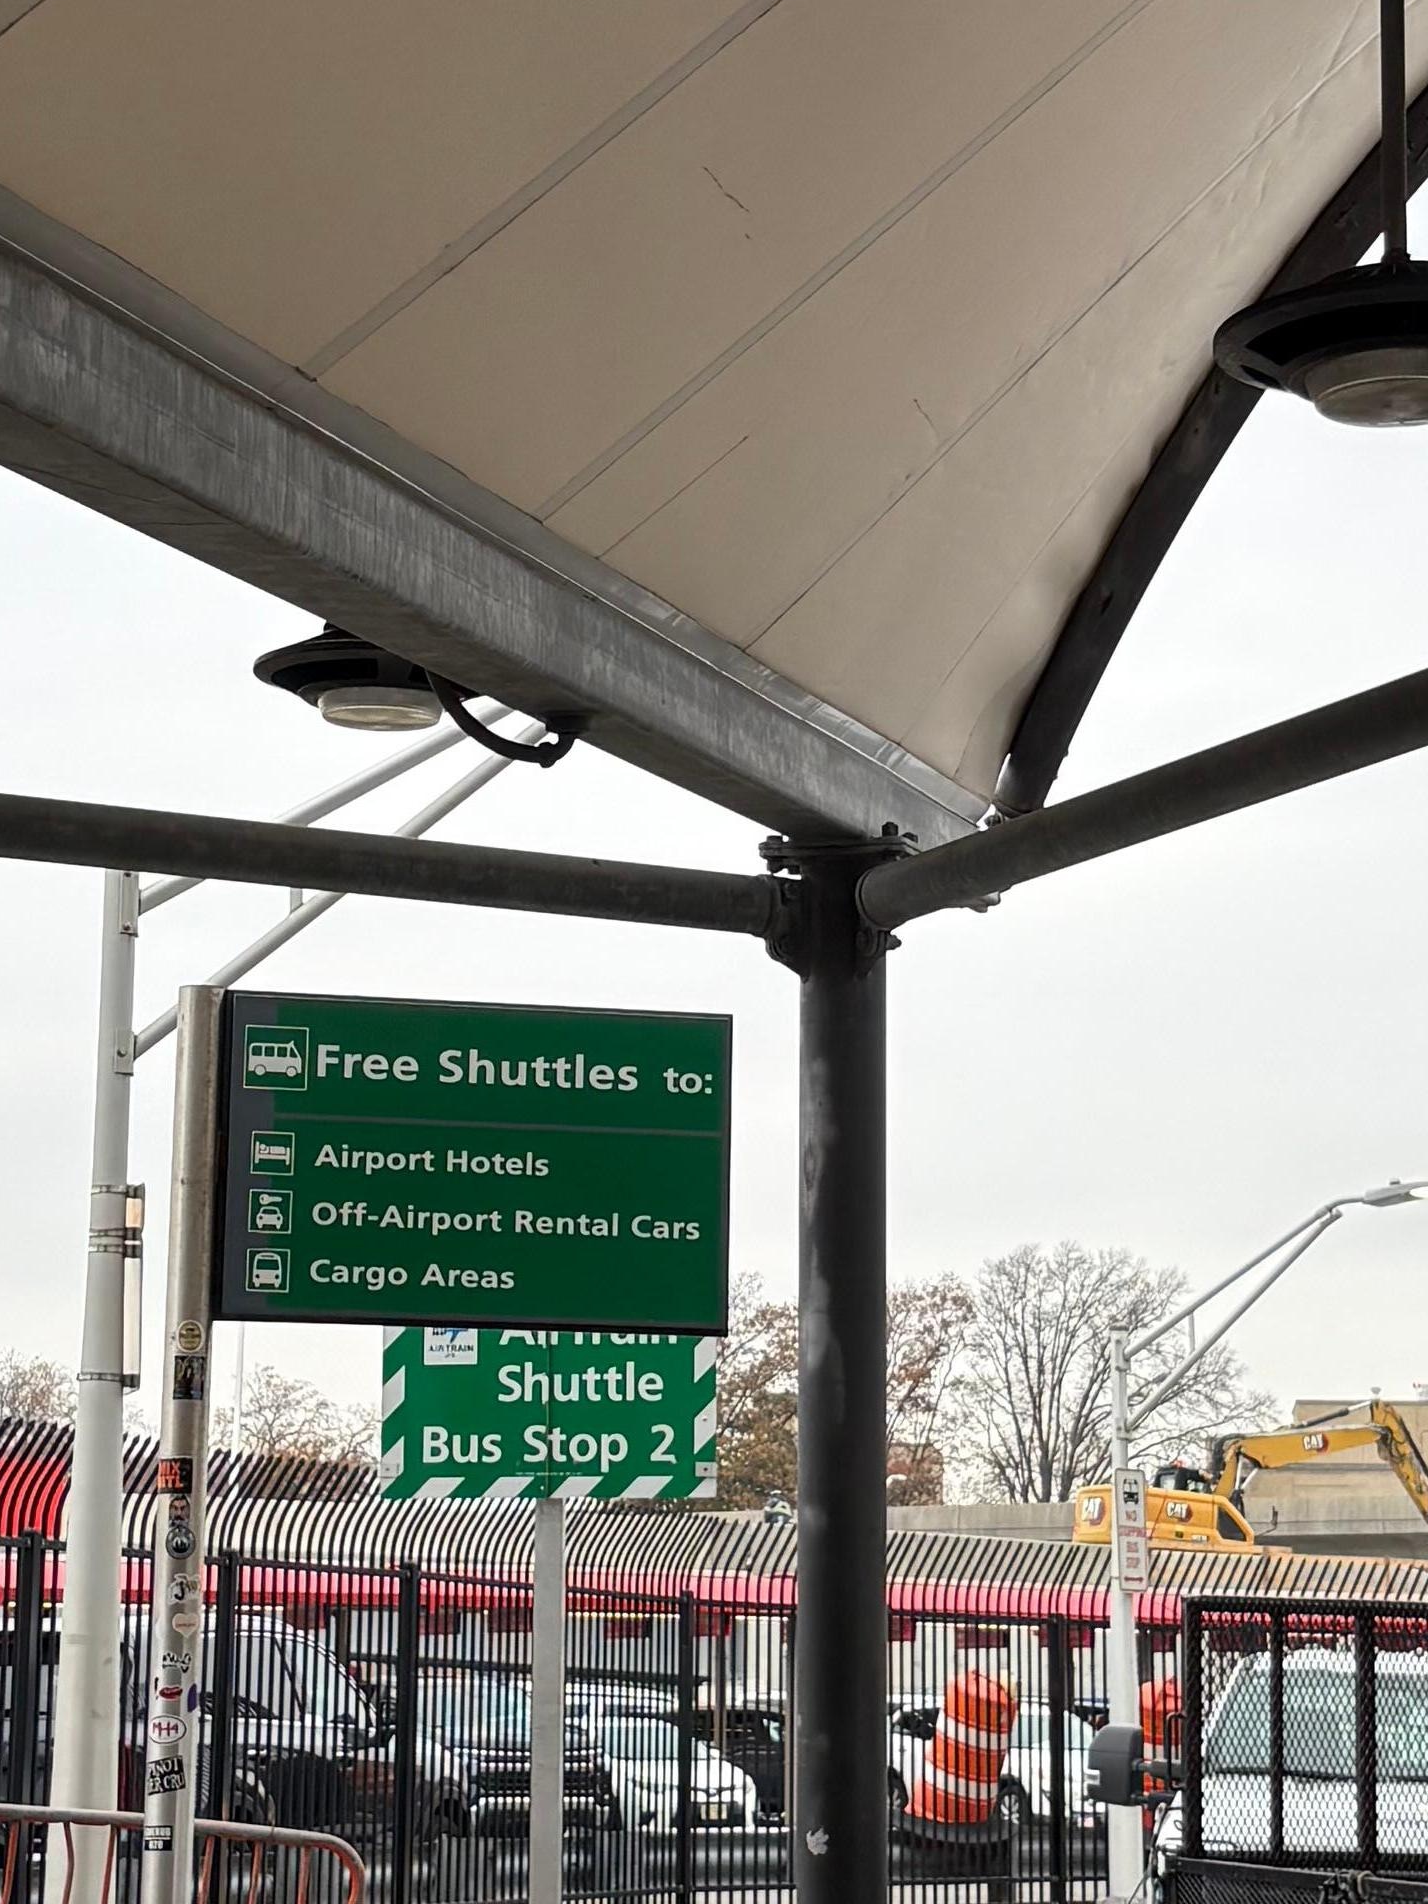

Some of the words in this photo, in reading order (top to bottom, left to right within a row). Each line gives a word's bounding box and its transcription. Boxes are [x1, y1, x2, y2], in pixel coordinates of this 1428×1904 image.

[316, 1044, 419, 1081] Free
[438, 1049, 639, 1091] Shuttles
[663, 1067, 713, 1094] to:
[314, 1144, 435, 1175] Airport
[446, 1149, 549, 1177] Hotels
[311, 1201, 503, 1236] Off-Airport
[514, 1210, 619, 1237] Rental
[630, 1215, 700, 1240] Cars
[309, 1259, 409, 1291] Cargo
[420, 1264, 515, 1289] Areas
[497, 1361, 665, 1404] Shuttle
[422, 1426, 503, 1463] Bus
[522, 1425, 629, 1473] Stop
[649, 1424, 677, 1464] 2
[1166, 1501, 1189, 1519] CAT
